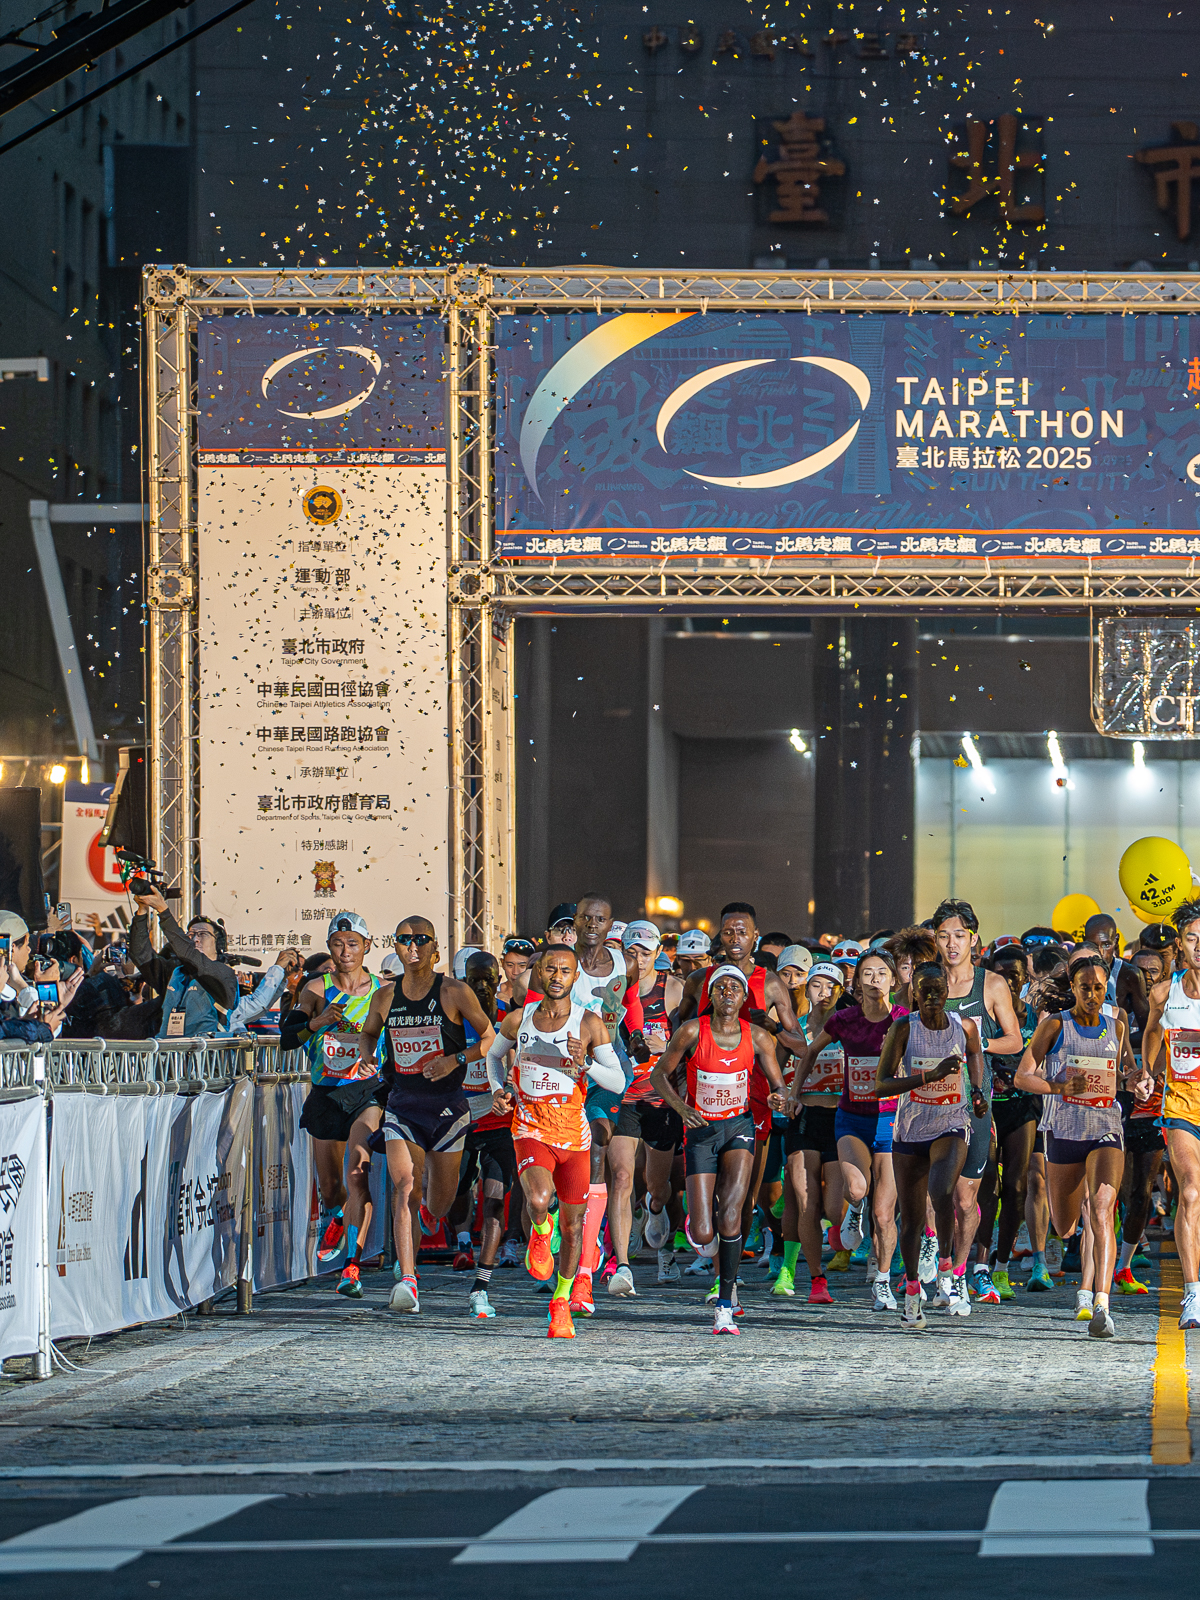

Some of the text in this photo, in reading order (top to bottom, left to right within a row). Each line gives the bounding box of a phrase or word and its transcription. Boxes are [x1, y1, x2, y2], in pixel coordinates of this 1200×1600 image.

[896, 377, 1031, 406] TAIPEI
[896, 410, 1125, 438] MARATHON
[896, 446, 1092, 470] 臺北馬拉松 2025
[295, 568, 350, 584] 運動部
[282, 638, 365, 655] 臺北市政府
[281, 658, 366, 667] Taipei City Government
[257, 681, 390, 698] 中華民國田徑協會
[256, 700, 390, 708] Chinese Taipei Athletics Association
[257, 726, 390, 743] 中華民國路跑協會
[300, 766, 349, 779] 承辦單位
[257, 795, 391, 811] 臺北市政府體育局
[301, 839, 348, 851] 特別感謝
[1140, 884, 1176, 901] 42 KM
[1151, 896, 1172, 907] 3:00
[388, 1015, 443, 1027] 曙光跑步學校
[396, 1039, 441, 1053] 09021
[542, 1073, 550, 1081] 2
[1087, 1075, 1101, 1084] 52
[532, 1081, 560, 1091] TEFERI
[716, 1089, 731, 1098] 53
[703, 1096, 742, 1106] KIPTUGEN
